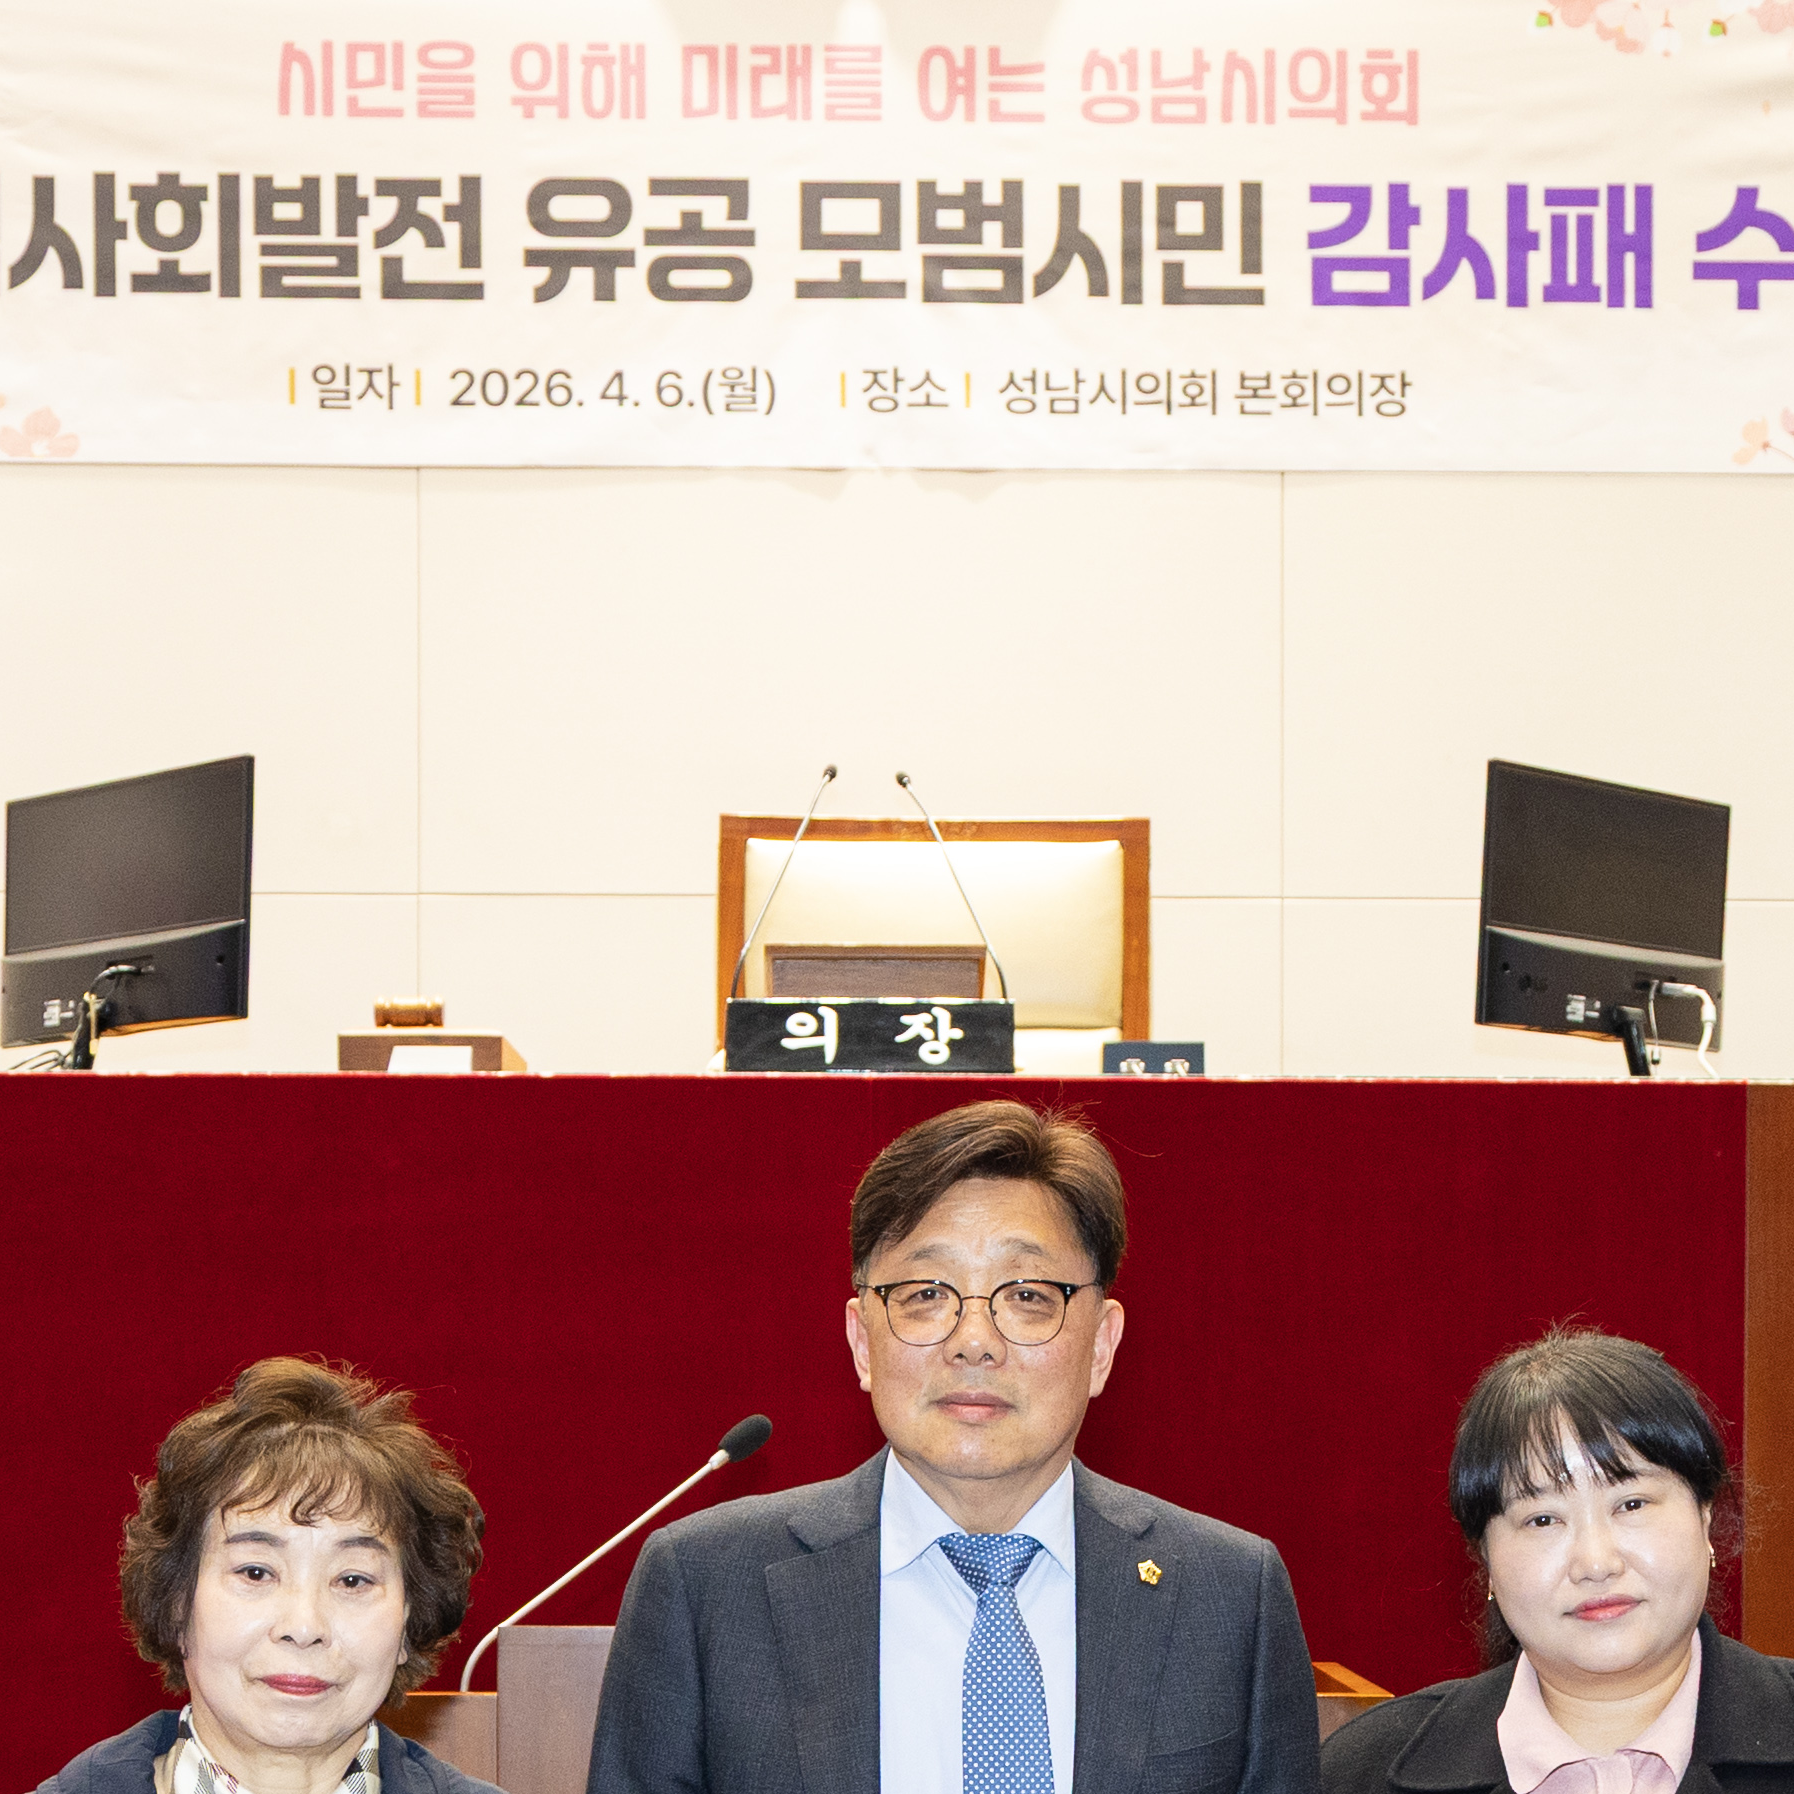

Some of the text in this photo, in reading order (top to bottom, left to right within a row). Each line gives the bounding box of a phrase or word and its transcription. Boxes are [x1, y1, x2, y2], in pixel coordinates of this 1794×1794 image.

[277, 40, 1420, 126] 시민을 위해 미래를 여는 성남시의회
[522, 175, 757, 304] 유공
[793, 178, 1267, 307] 모범시민
[1306, 180, 1655, 310] 감사패
[310, 362, 1412, 419] 일자 2026. 4. 6.(월) 장소 성남시의회 본회의장
